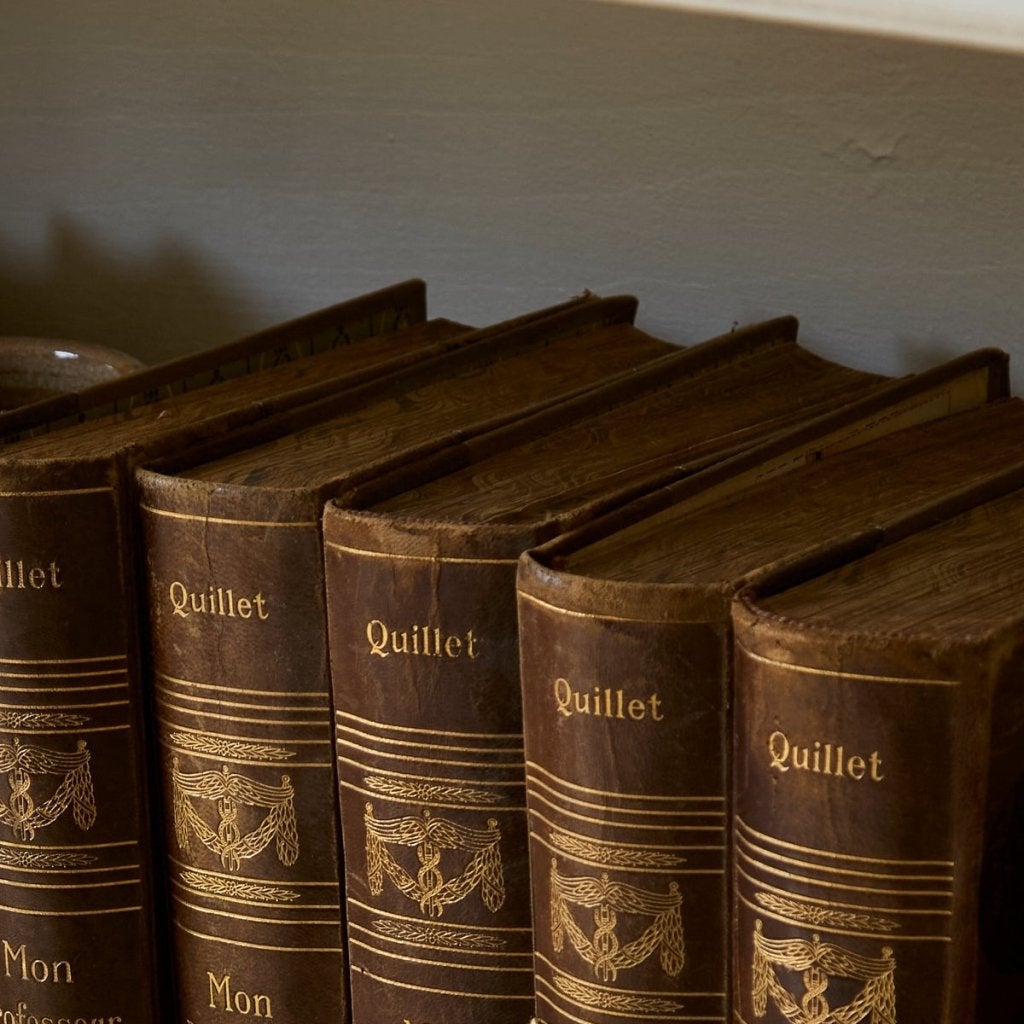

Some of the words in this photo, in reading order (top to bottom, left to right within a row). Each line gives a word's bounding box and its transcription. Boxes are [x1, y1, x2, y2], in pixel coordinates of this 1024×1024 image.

[169, 581, 269, 620] Quillet
[365, 619, 478, 660] Quillet
[554, 677, 664, 722] Quillet
[768, 730, 884, 782] Quillet
[2, 940, 75, 984] Mon
[207, 971, 274, 1019] Mon
